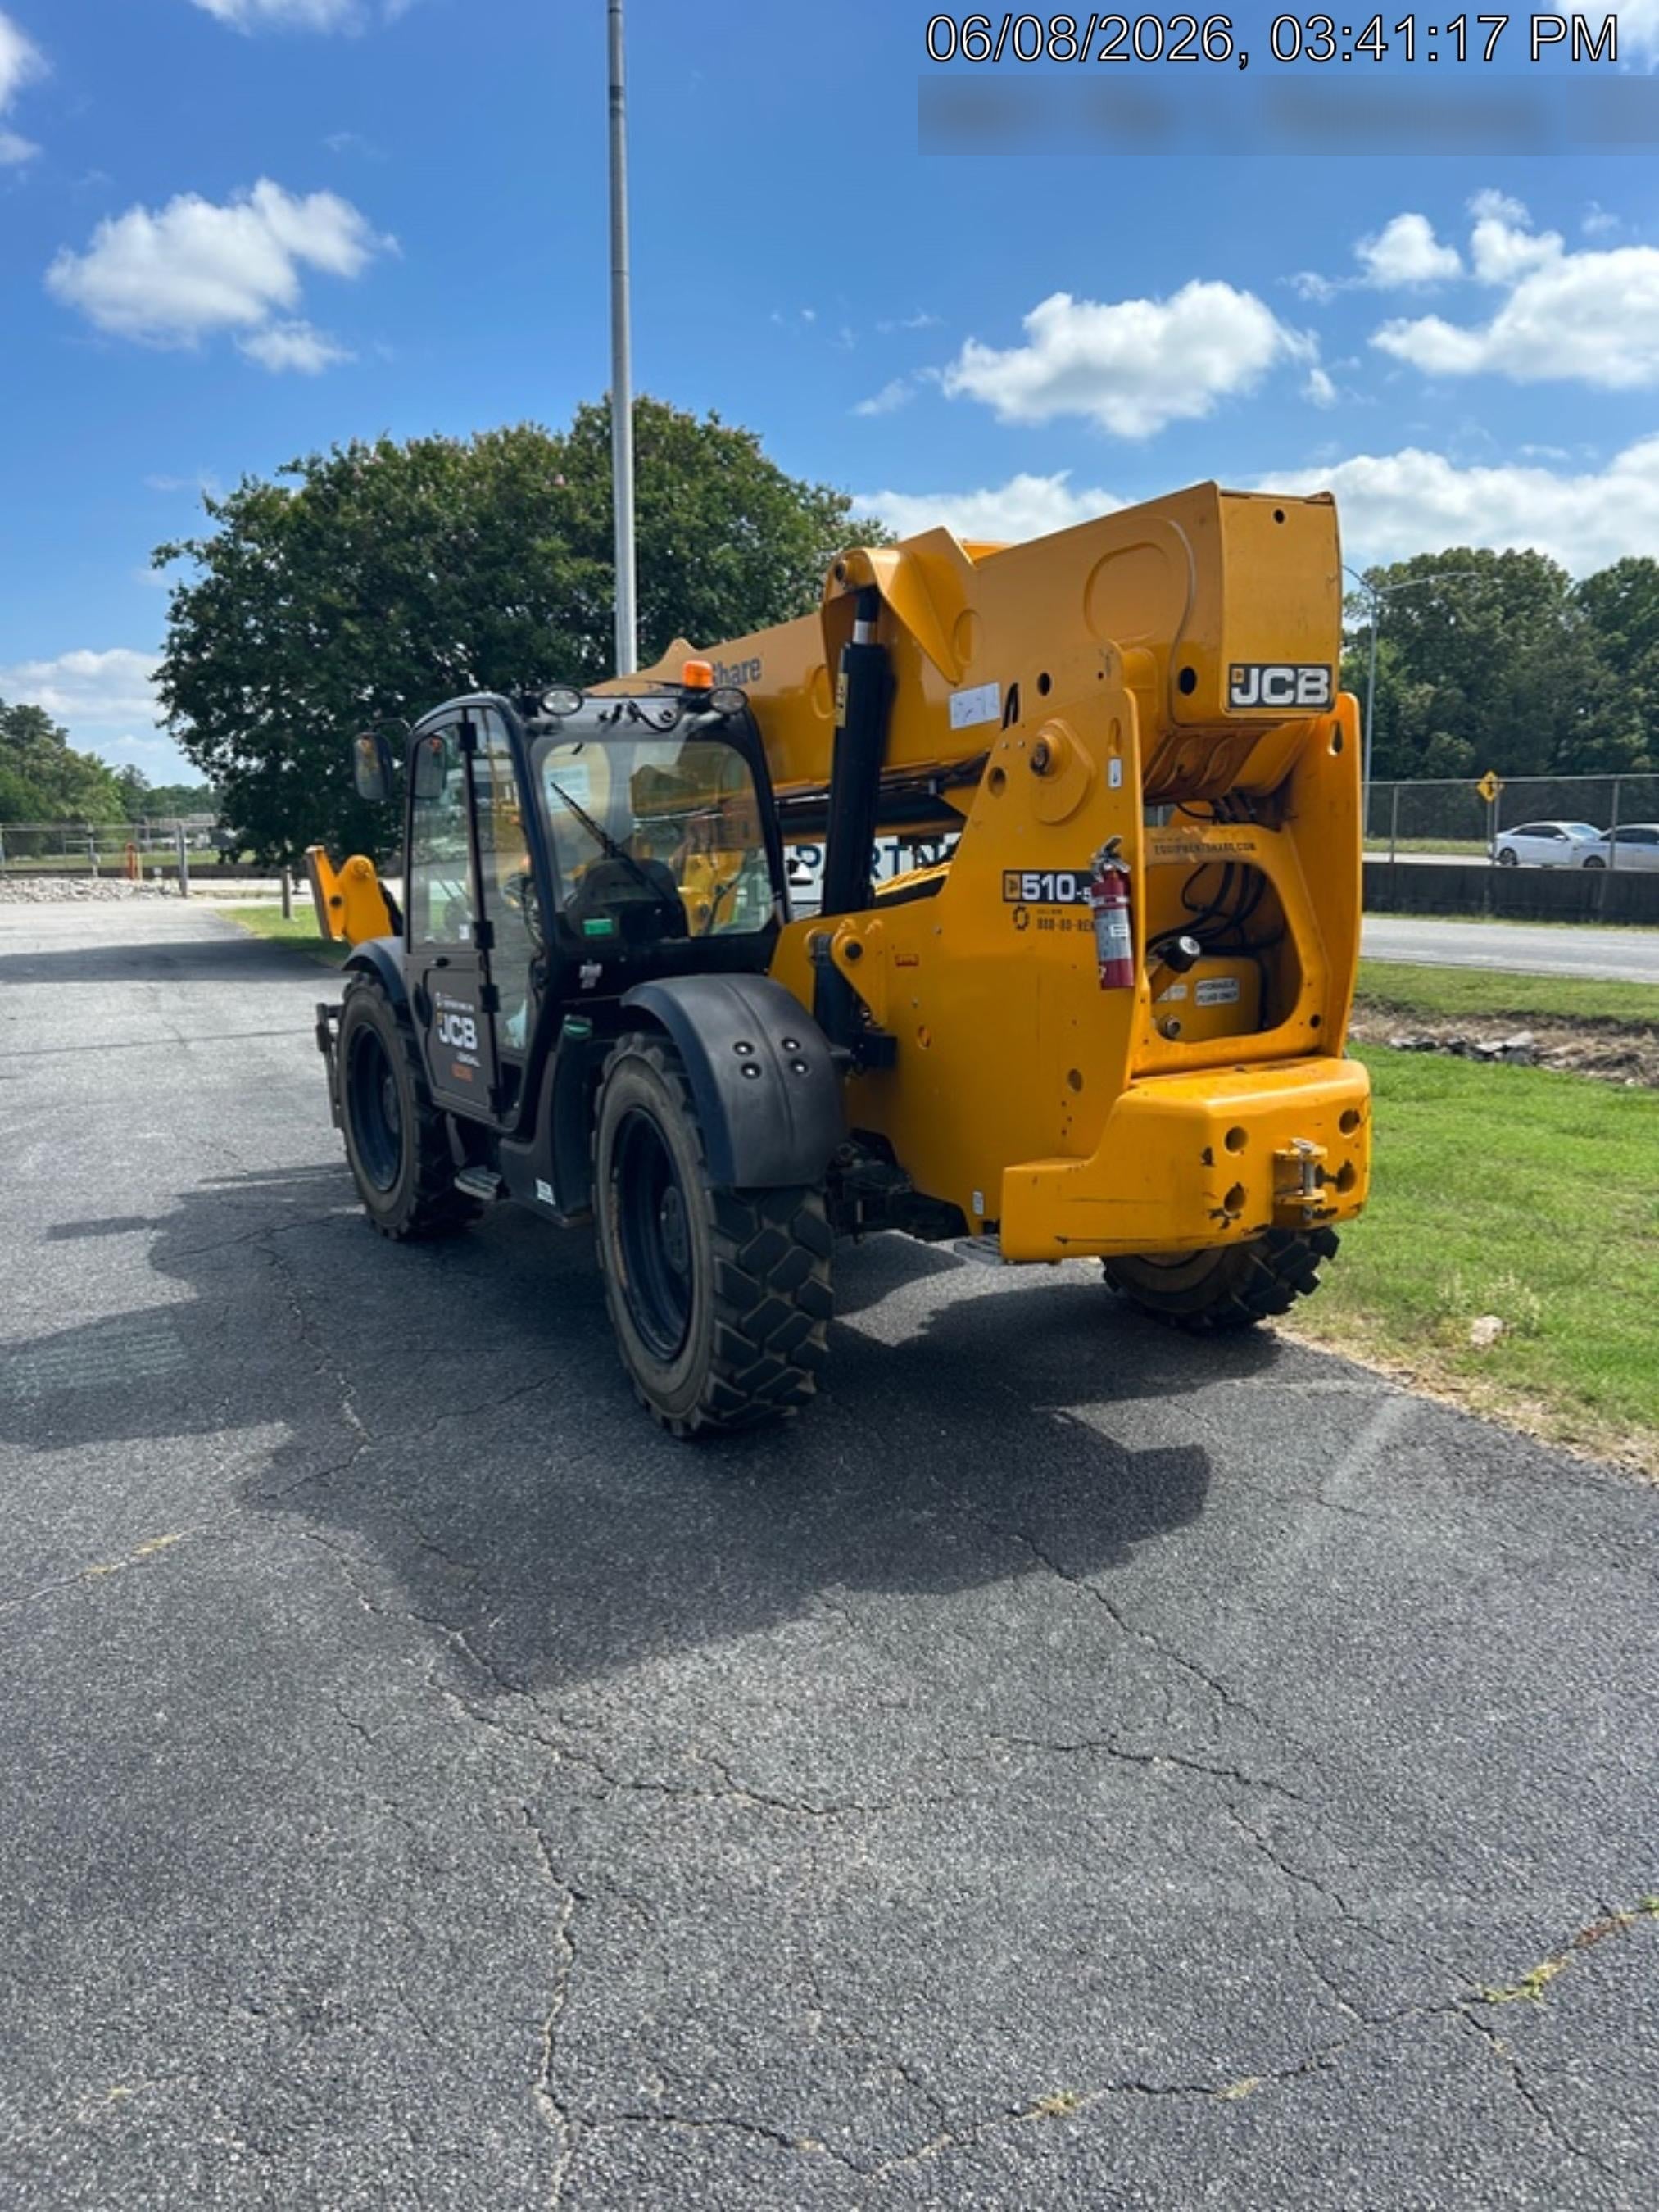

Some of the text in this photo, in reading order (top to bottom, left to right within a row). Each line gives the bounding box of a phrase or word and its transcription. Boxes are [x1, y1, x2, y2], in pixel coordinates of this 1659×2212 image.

[712, 658, 762, 688] hare
[1231, 667, 1329, 705] JCB
[438, 1013, 478, 1049] JCB
